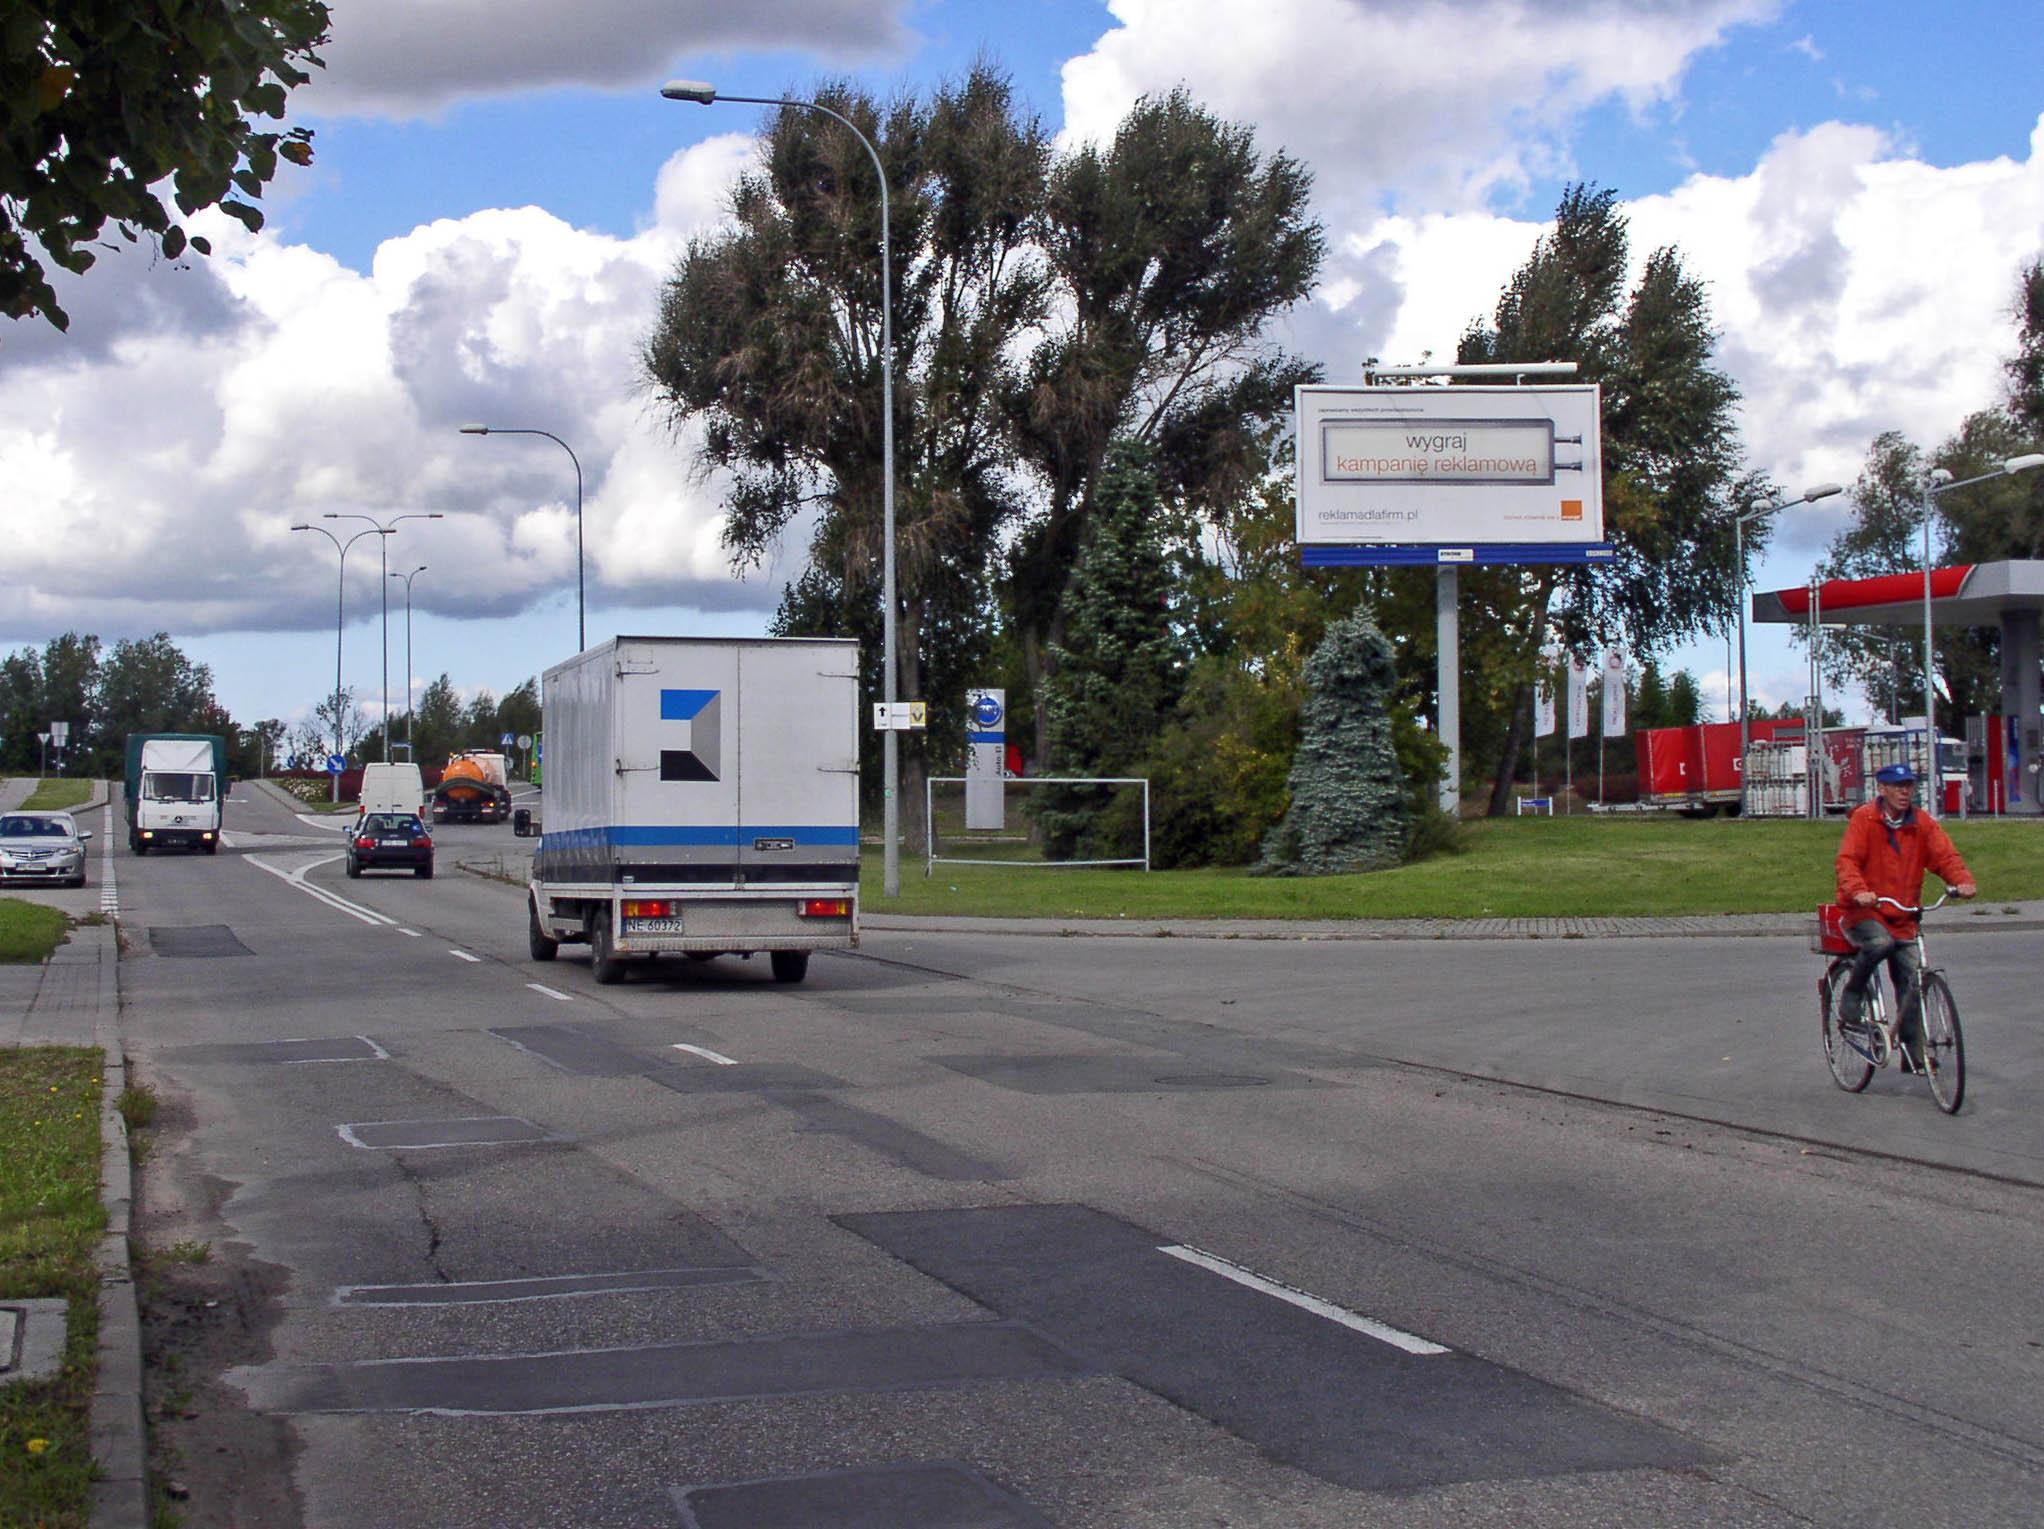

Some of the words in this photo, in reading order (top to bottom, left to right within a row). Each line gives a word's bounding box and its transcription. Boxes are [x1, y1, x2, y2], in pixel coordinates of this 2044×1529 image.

[1406, 432, 1467, 452] wygraj
[1337, 456, 1428, 476] kampanię
[1434, 456, 1537, 476] reklamową
[1318, 509, 1418, 523] reklamadlafirm.pl
[628, 919, 644, 931] NE
[647, 919, 681, 931] 60372
